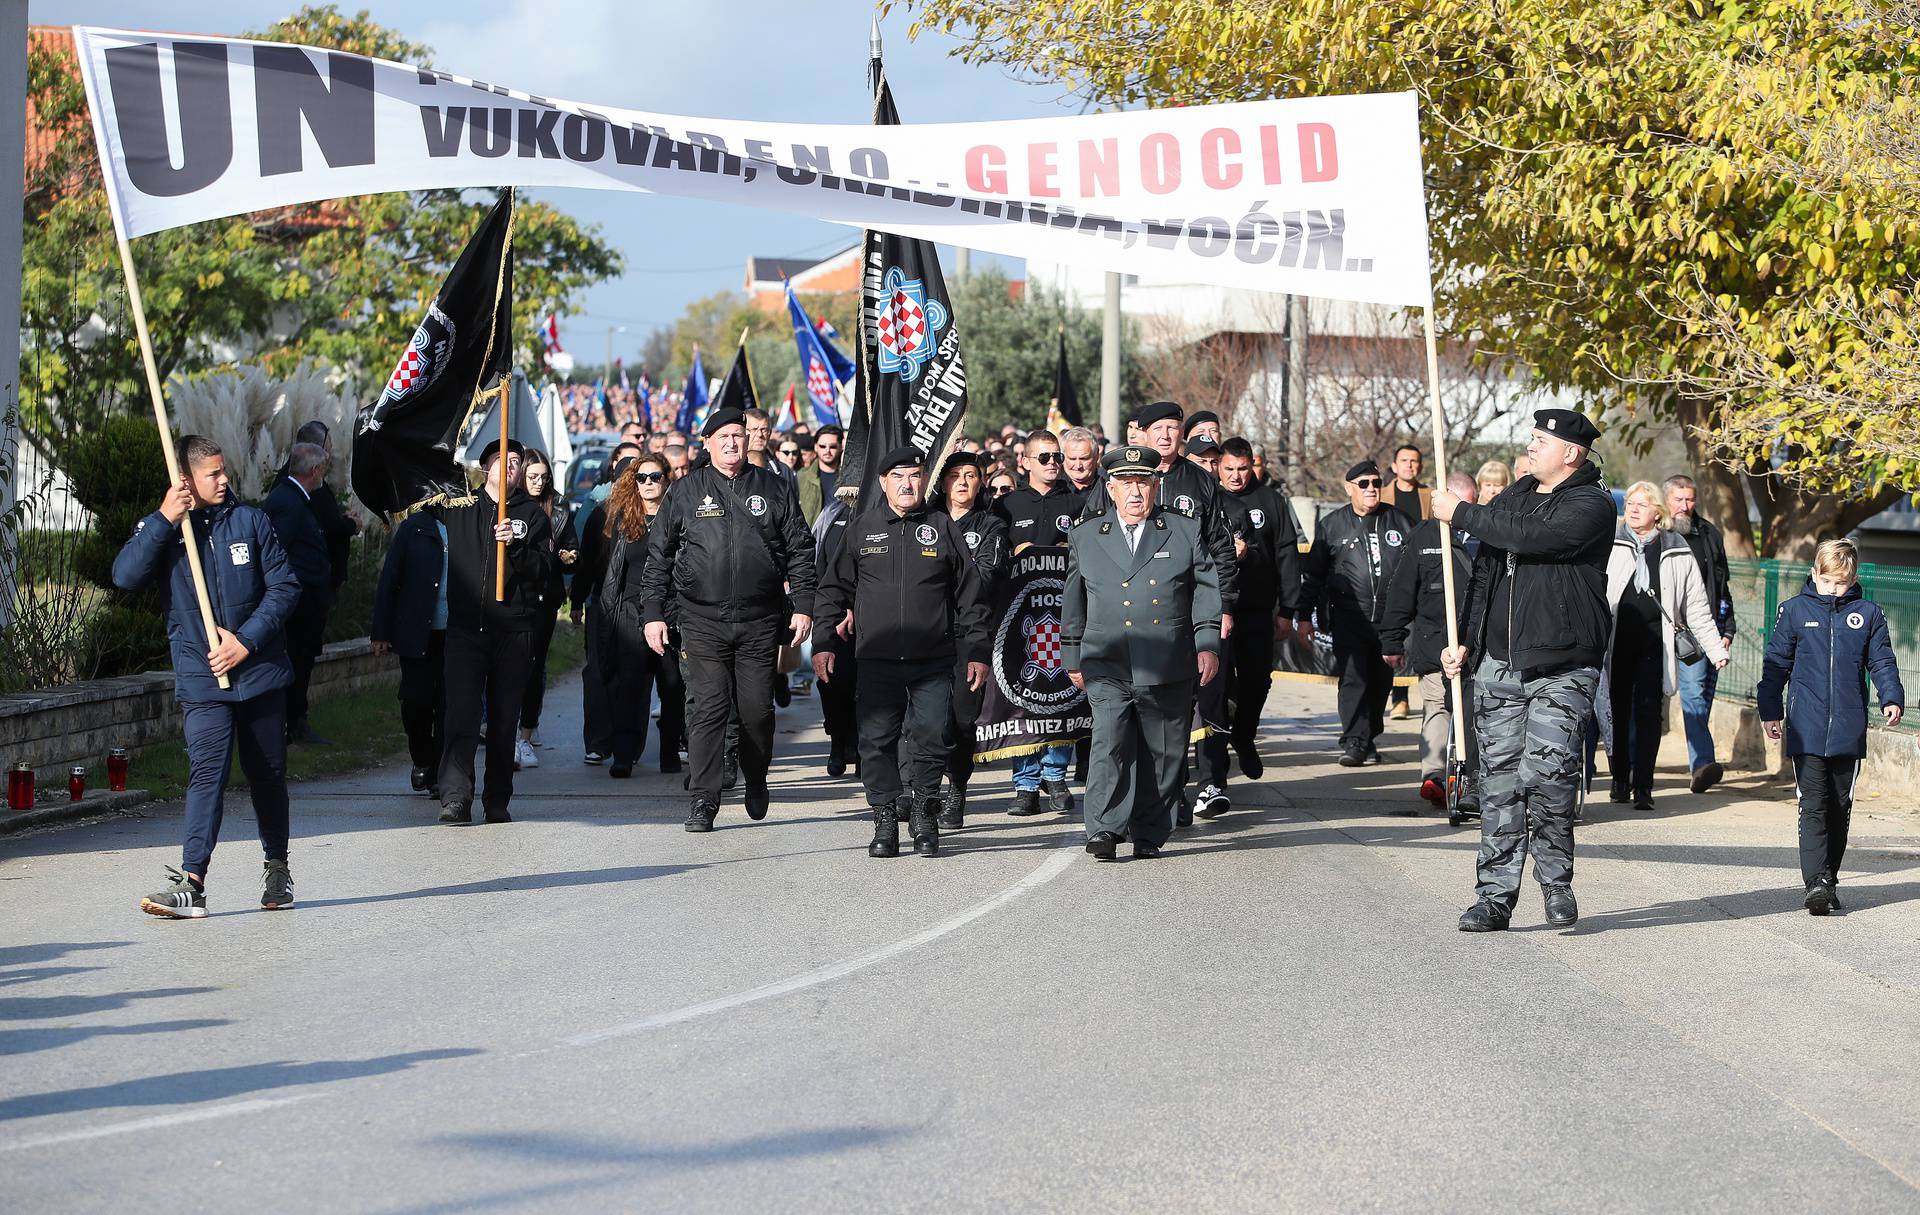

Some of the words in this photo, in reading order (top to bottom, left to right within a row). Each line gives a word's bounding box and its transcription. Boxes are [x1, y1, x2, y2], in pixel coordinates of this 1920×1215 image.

[105, 42, 375, 197] UN
[965, 122, 1339, 198] GENOCID
[904, 402, 925, 428] ZA
[917, 361, 944, 401] DOM
[937, 324, 960, 361] SPR
[910, 394, 956, 459] AFAEL
[1021, 555, 1065, 574] BOJNA
[1030, 593, 1063, 608] HOS
[1012, 681, 1022, 693] ZA
[1023, 688, 1047, 702] DOM
[976, 719, 1022, 742] RAFAEL
[1026, 719, 1063, 734] VITEZ
[1066, 716, 1094, 732] BOB
